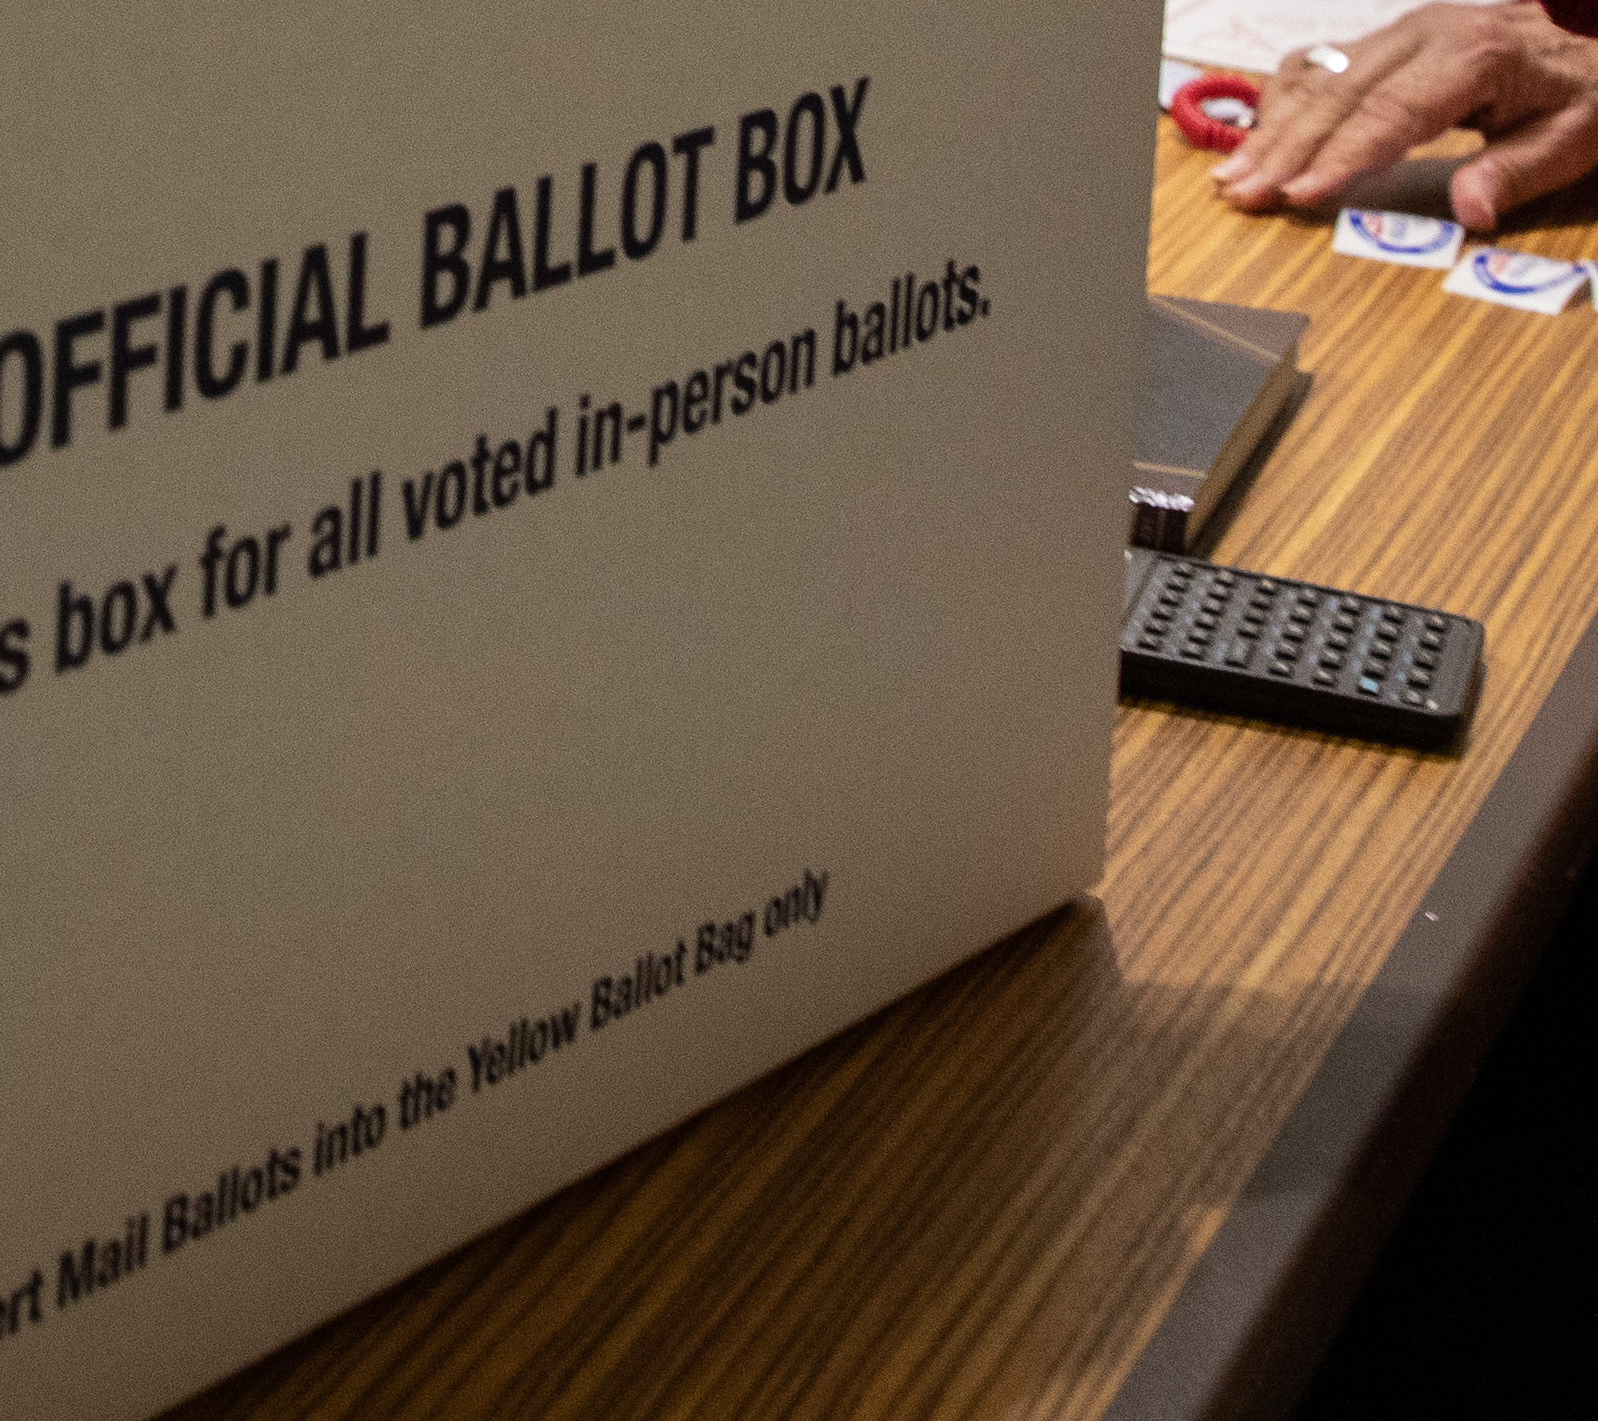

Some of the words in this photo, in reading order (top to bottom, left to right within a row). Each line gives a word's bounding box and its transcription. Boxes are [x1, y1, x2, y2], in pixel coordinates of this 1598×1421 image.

[421, 127, 714, 328] BALLOT
[735, 78, 868, 223] BOX
[55, 567, 176, 673] box
[200, 525, 290, 618] for
[308, 472, 381, 578] all
[403, 408, 557, 540] voted
[576, 329, 816, 476] in-person
[832, 260, 989, 376] ballots.
[57, 1215, 148, 1309] Mail
[162, 1148, 301, 1255] Ballots
[313, 1105, 386, 1176] into
[399, 1069, 456, 1130] the
[468, 1004, 580, 1093] Yellow
[590, 941, 687, 1031] Ballot
[694, 912, 755, 975] Bag
[763, 869, 829, 945] only
